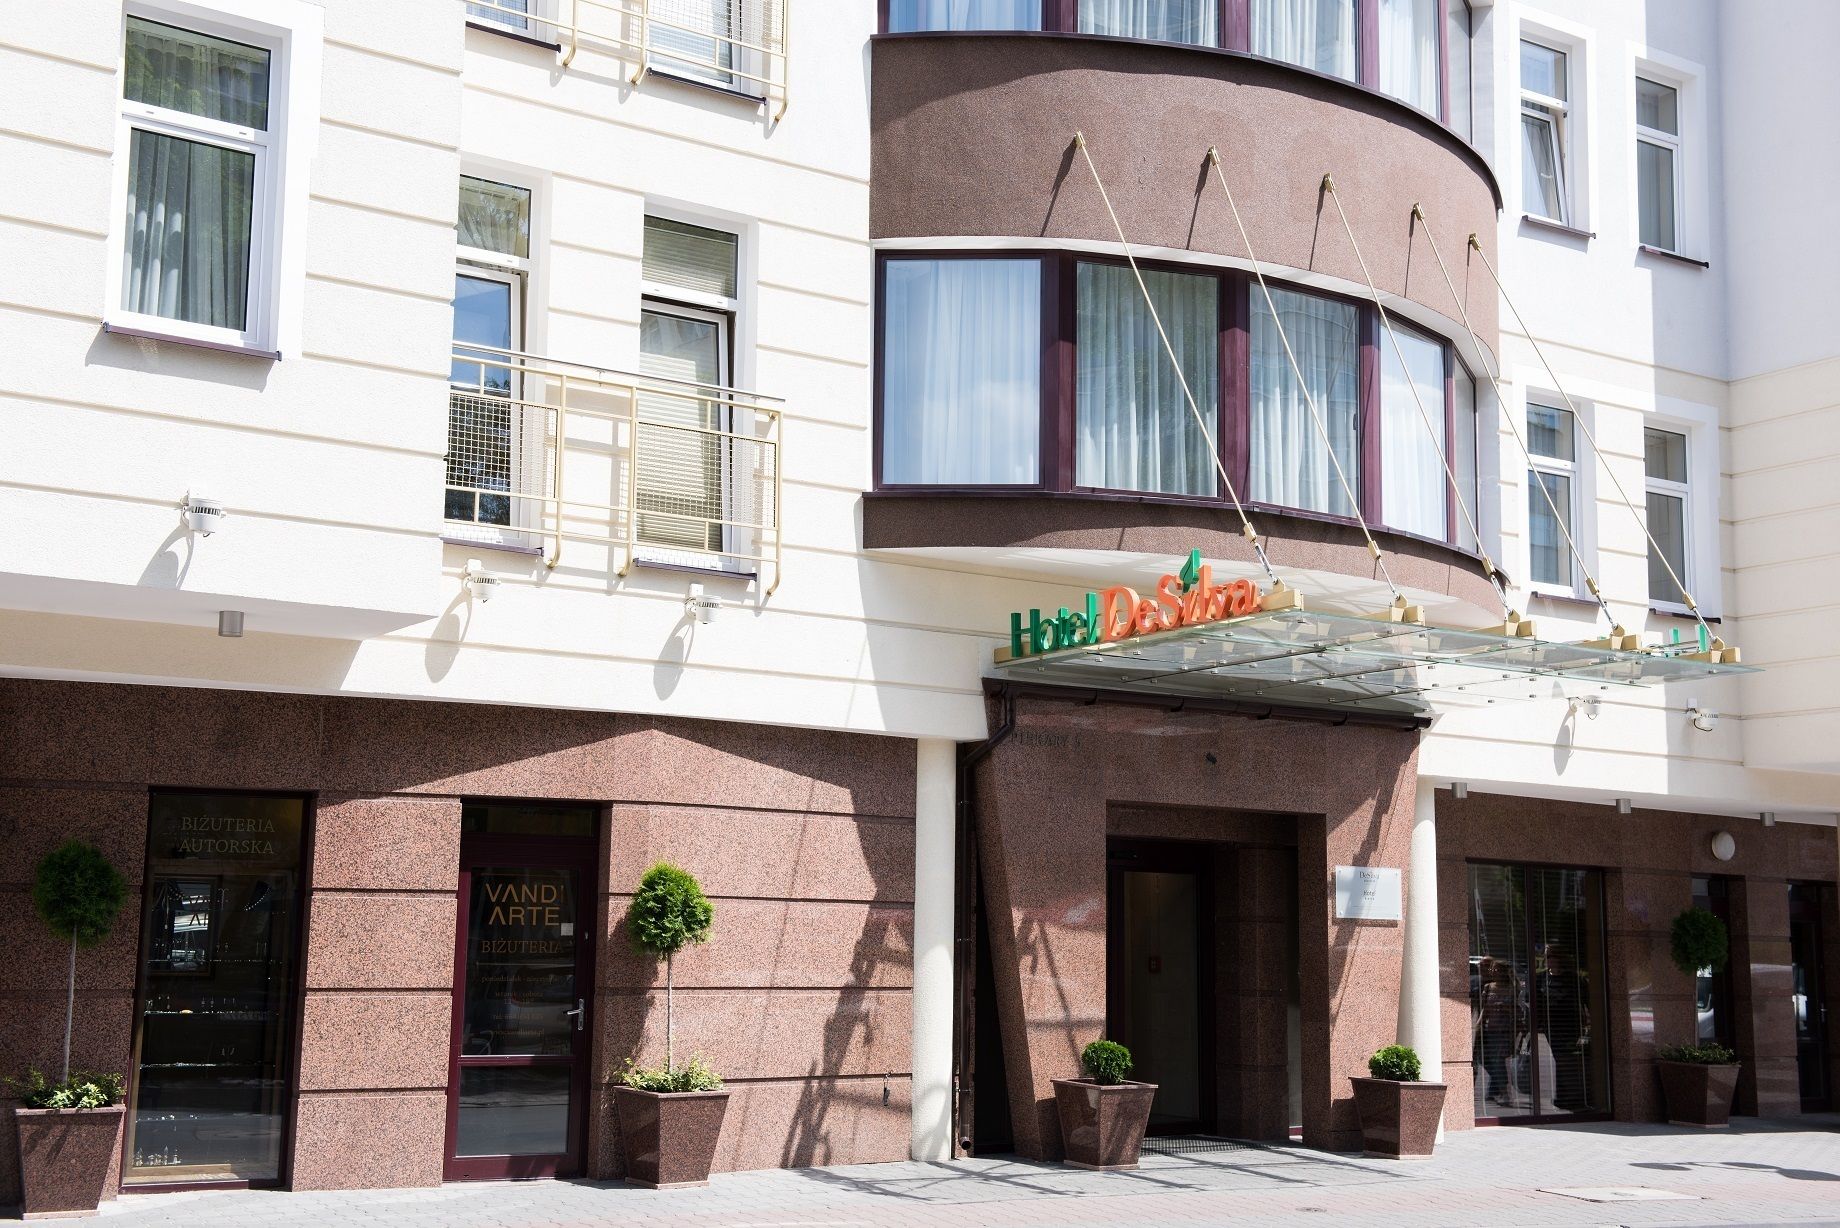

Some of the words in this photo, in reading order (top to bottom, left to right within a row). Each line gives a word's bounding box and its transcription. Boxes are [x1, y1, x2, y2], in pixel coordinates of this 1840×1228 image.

[1010, 592, 1097, 658] Hotel
[1101, 548, 1262, 641] DeSilva
[181, 814, 275, 833] BIŻUTERIA
[179, 839, 274, 854] AUTORSKA
[485, 883, 564, 903] VANDI
[488, 906, 560, 926] ARTE
[482, 938, 564, 954] BIŻUTERIA
